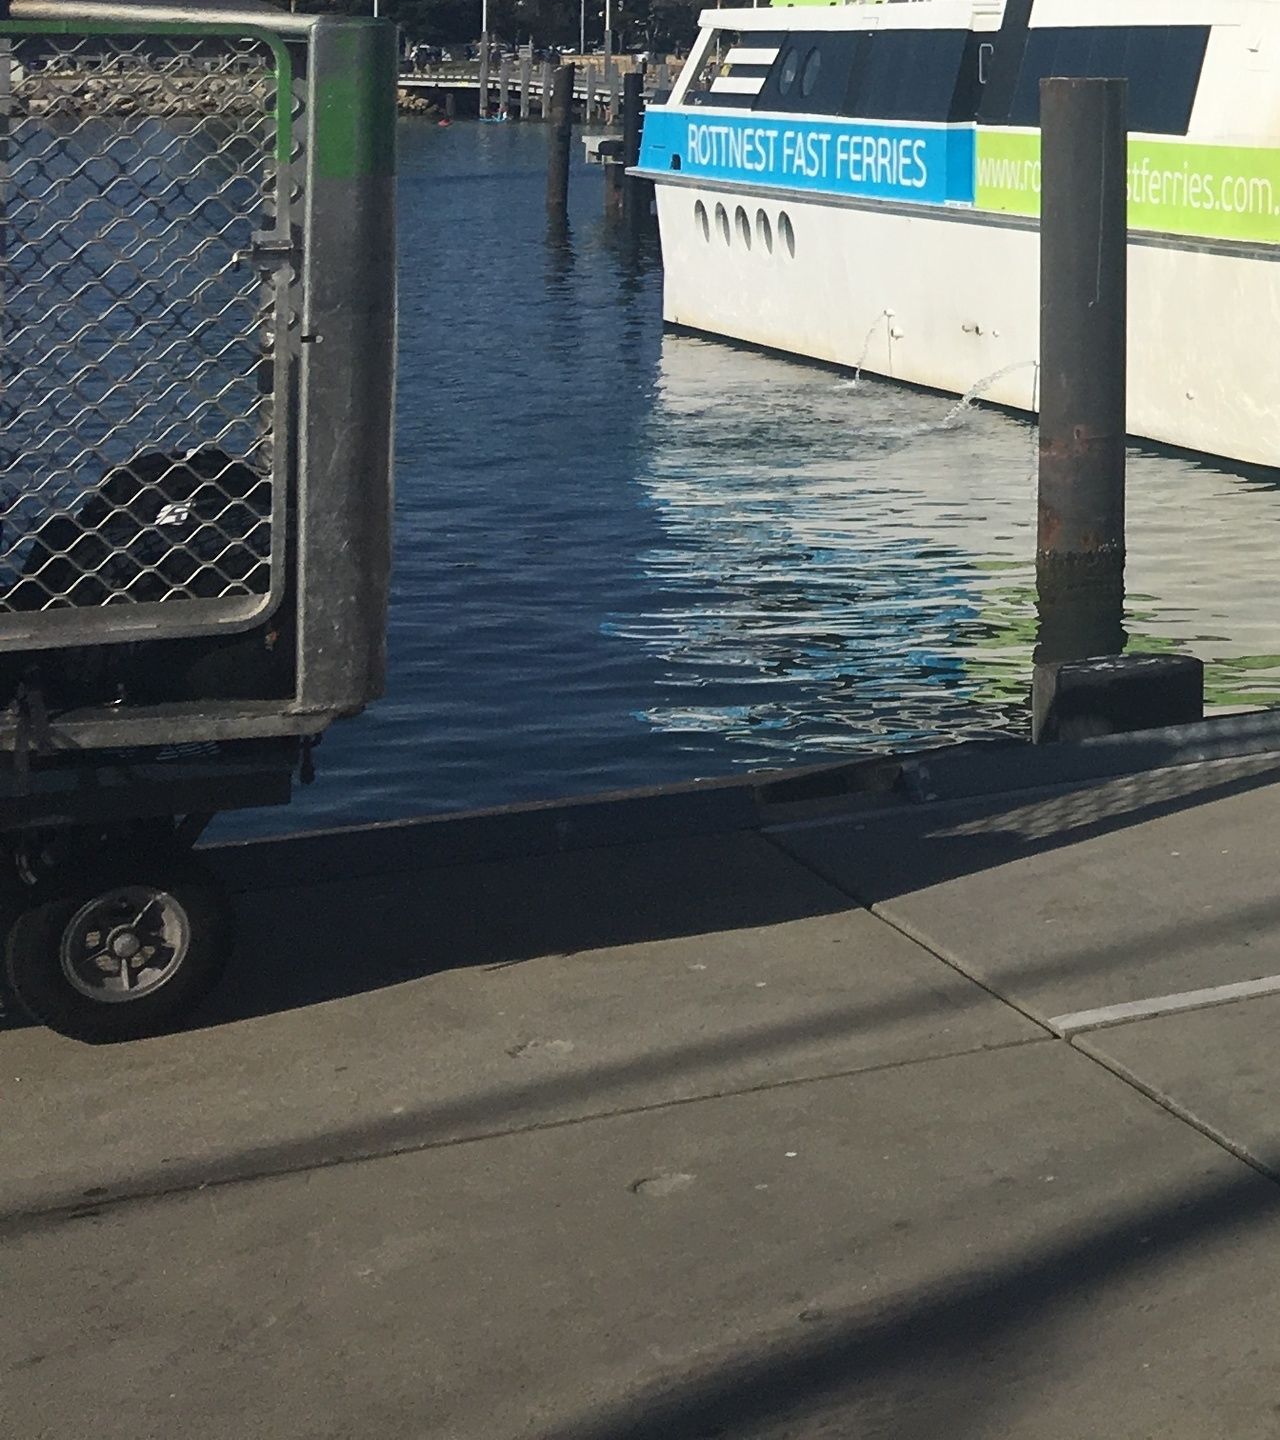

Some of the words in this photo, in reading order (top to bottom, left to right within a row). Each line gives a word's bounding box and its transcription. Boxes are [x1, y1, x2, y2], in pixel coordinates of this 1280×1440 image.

[687, 123, 779, 172] ROTTNEST
[782, 130, 831, 178] FAST
[836, 134, 928, 188] FERRIES
